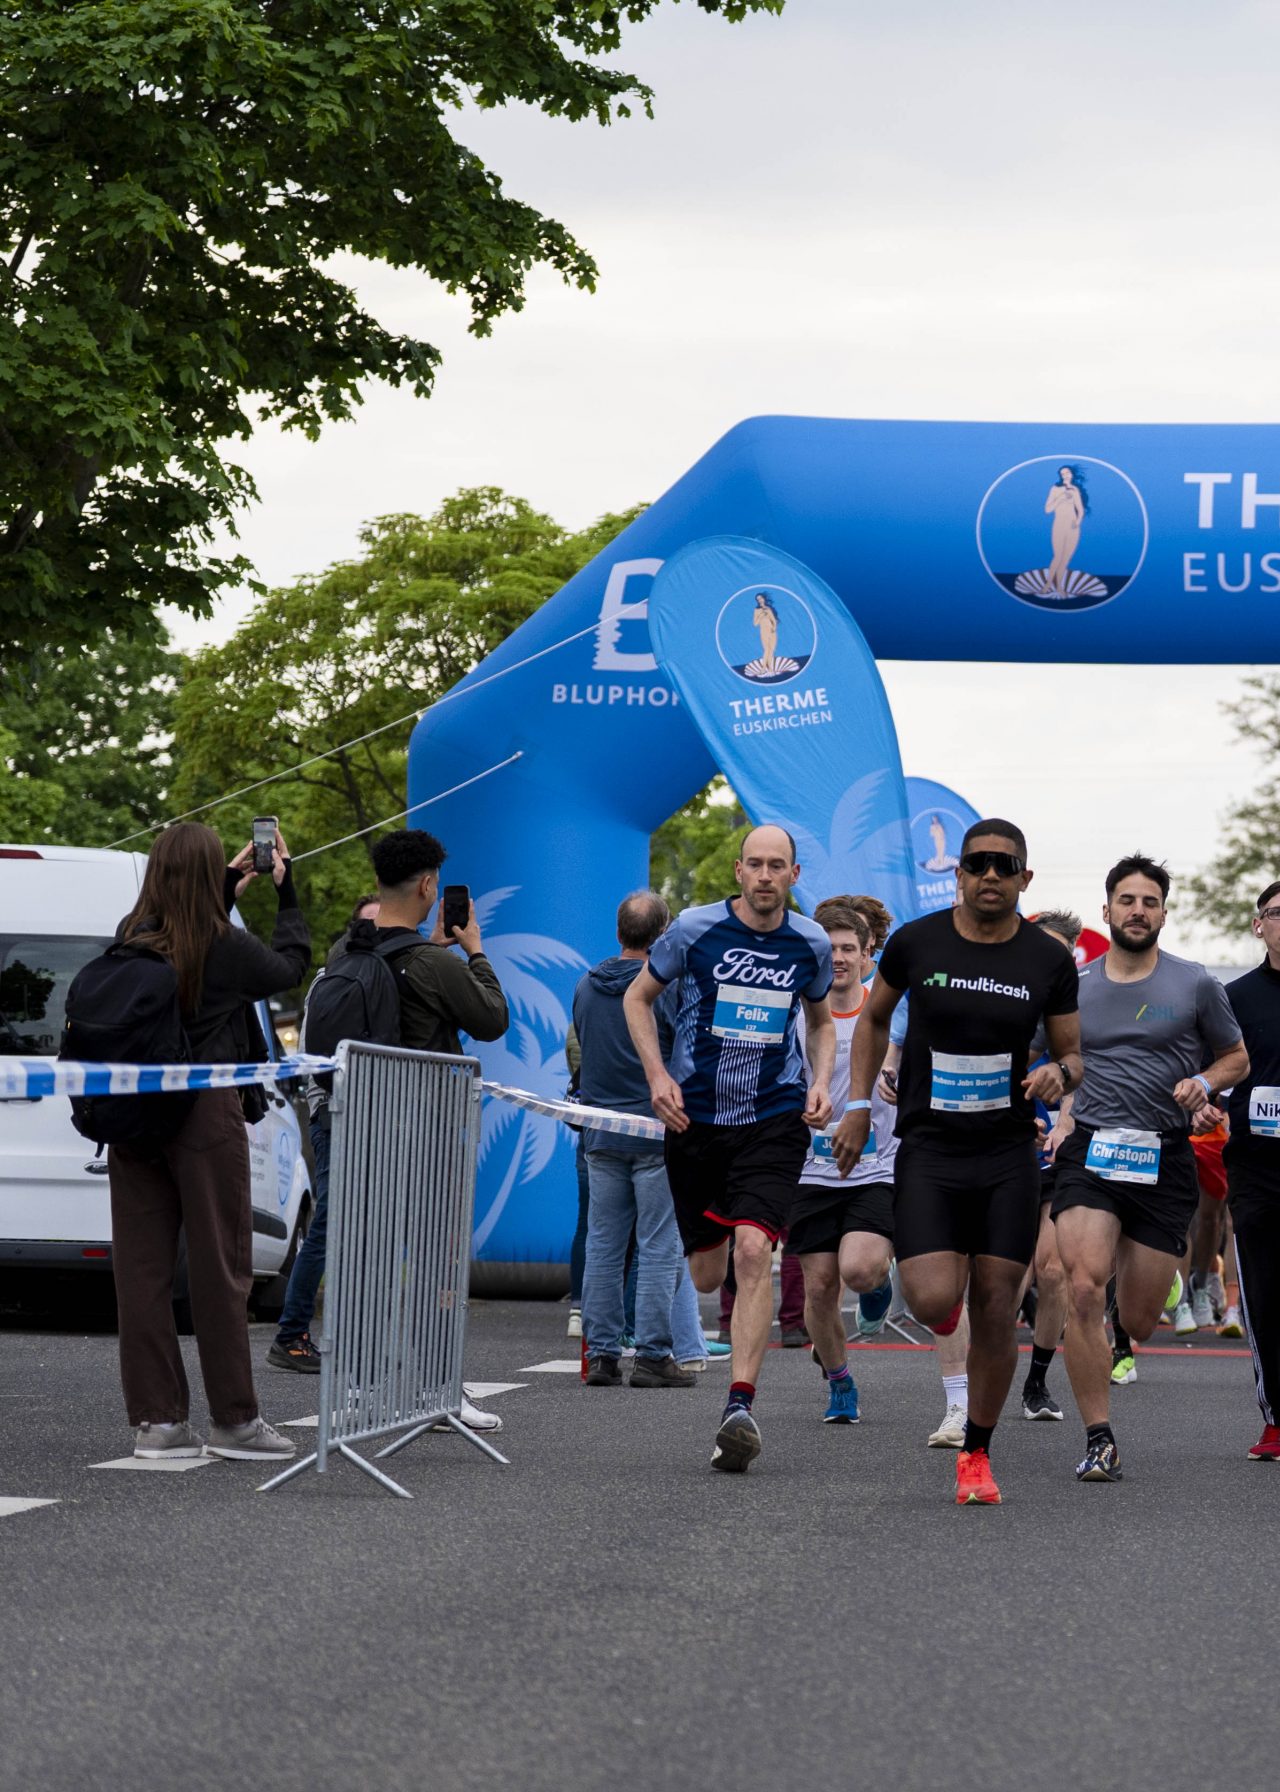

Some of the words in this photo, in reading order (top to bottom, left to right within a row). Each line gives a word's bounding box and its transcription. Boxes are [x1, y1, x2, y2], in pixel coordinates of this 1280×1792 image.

[729, 688, 829, 718] THERME
[733, 710, 833, 736] EUSKIRCHEN
[713, 948, 797, 988] Ford
[950, 977, 1030, 1000] multicash
[736, 1005, 770, 1022] Felix
[1092, 1143, 1156, 1165] Christoph
